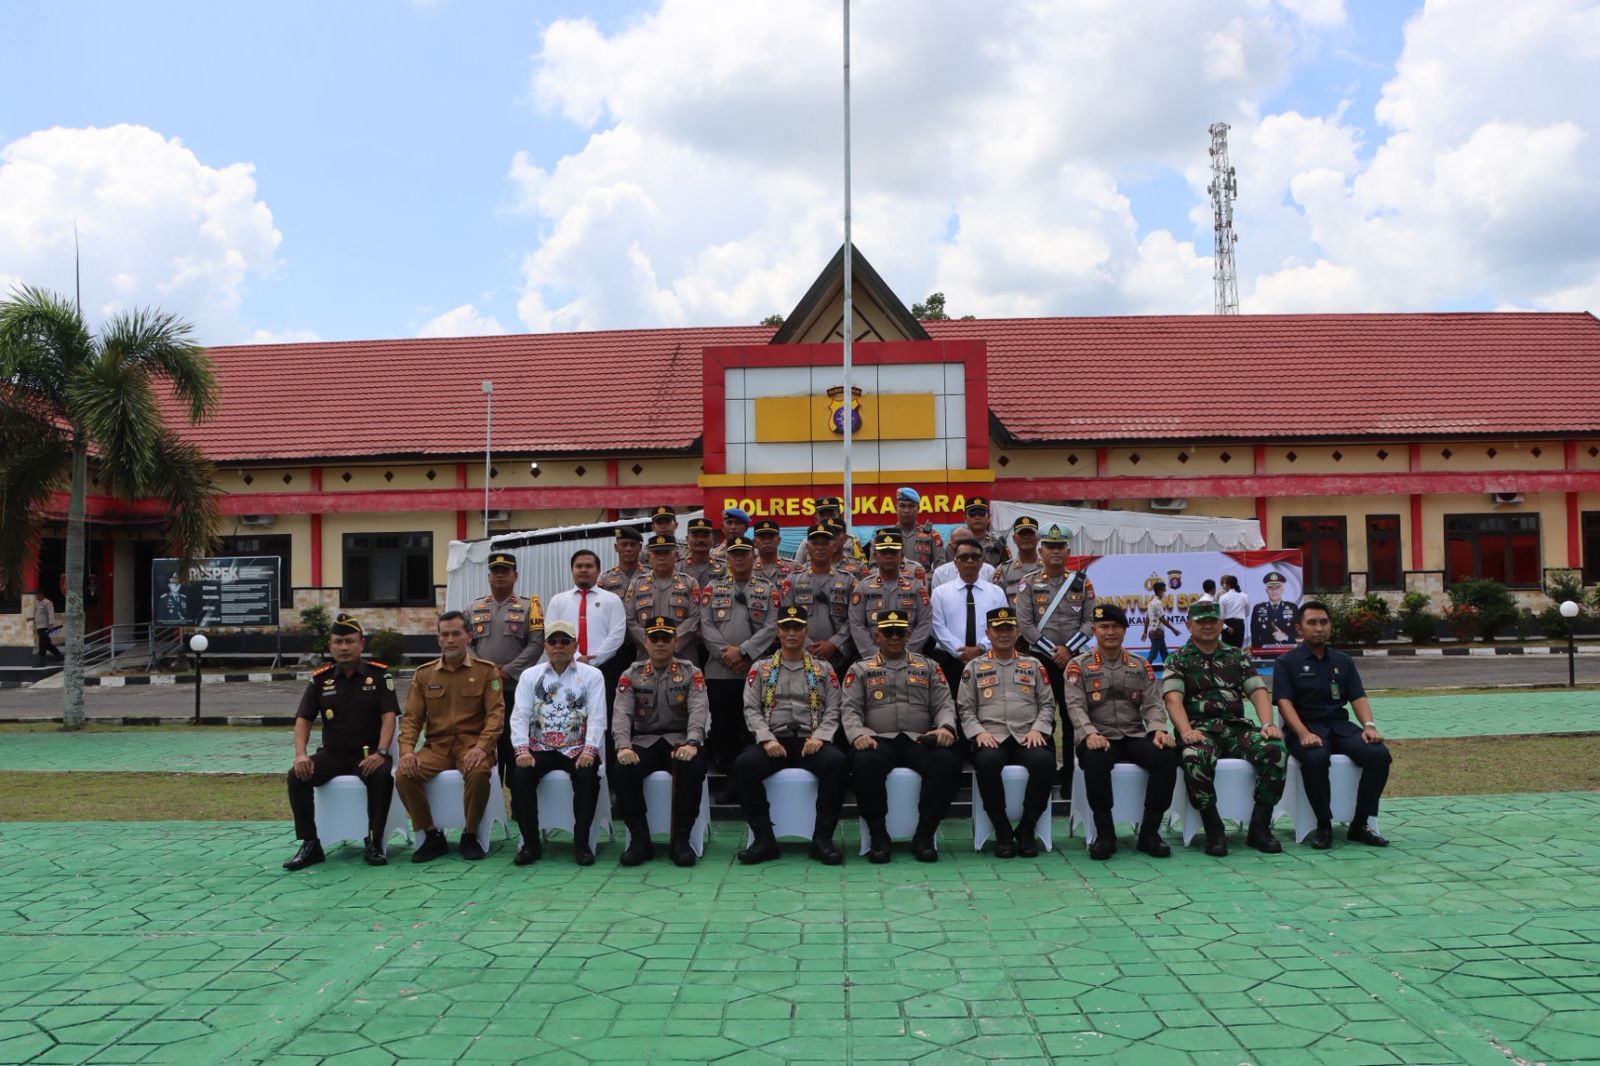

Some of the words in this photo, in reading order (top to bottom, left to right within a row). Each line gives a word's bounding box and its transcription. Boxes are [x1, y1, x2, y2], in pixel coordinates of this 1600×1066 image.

[723, 497, 816, 516] POLRES
[837, 494, 967, 515] UKAARA
[1095, 594, 1174, 610] BANTUN
